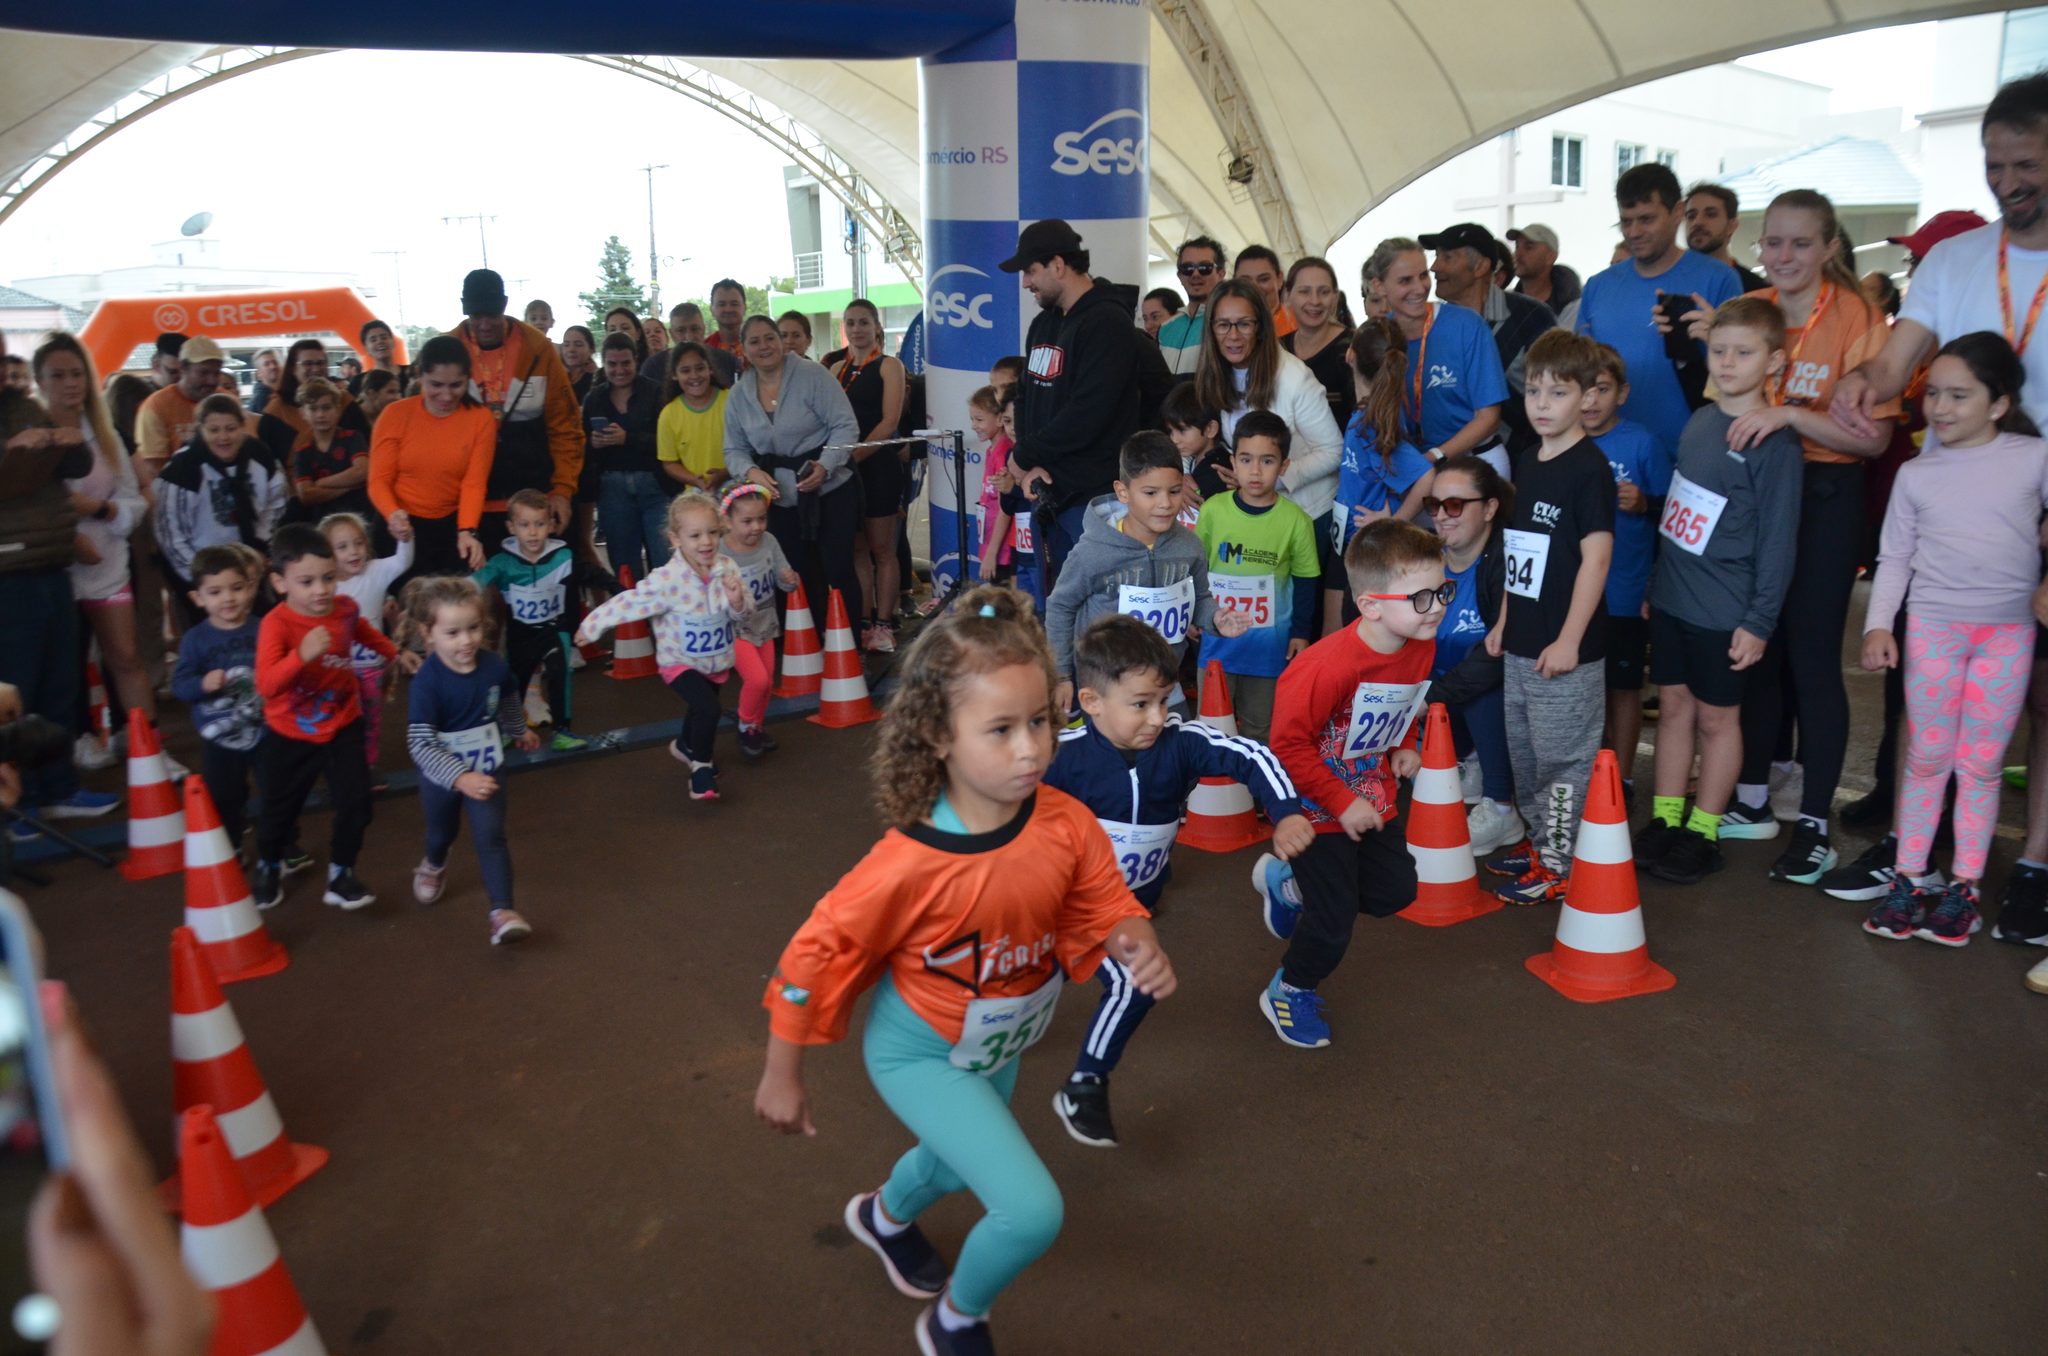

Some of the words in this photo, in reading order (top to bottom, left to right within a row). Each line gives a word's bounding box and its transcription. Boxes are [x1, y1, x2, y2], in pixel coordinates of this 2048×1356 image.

[927, 146, 976, 164] mércio
[982, 146, 1008, 164] RS
[199, 300, 318, 327] CRESOL
[925, 289, 993, 329] esc
[1507, 554, 1534, 590] 94
[515, 594, 560, 620] 2234
[685, 621, 734, 653] 2220
[1363, 693, 1385, 703] Sesc
[1106, 833, 1127, 843] esc
[1121, 847, 1167, 887] 38
